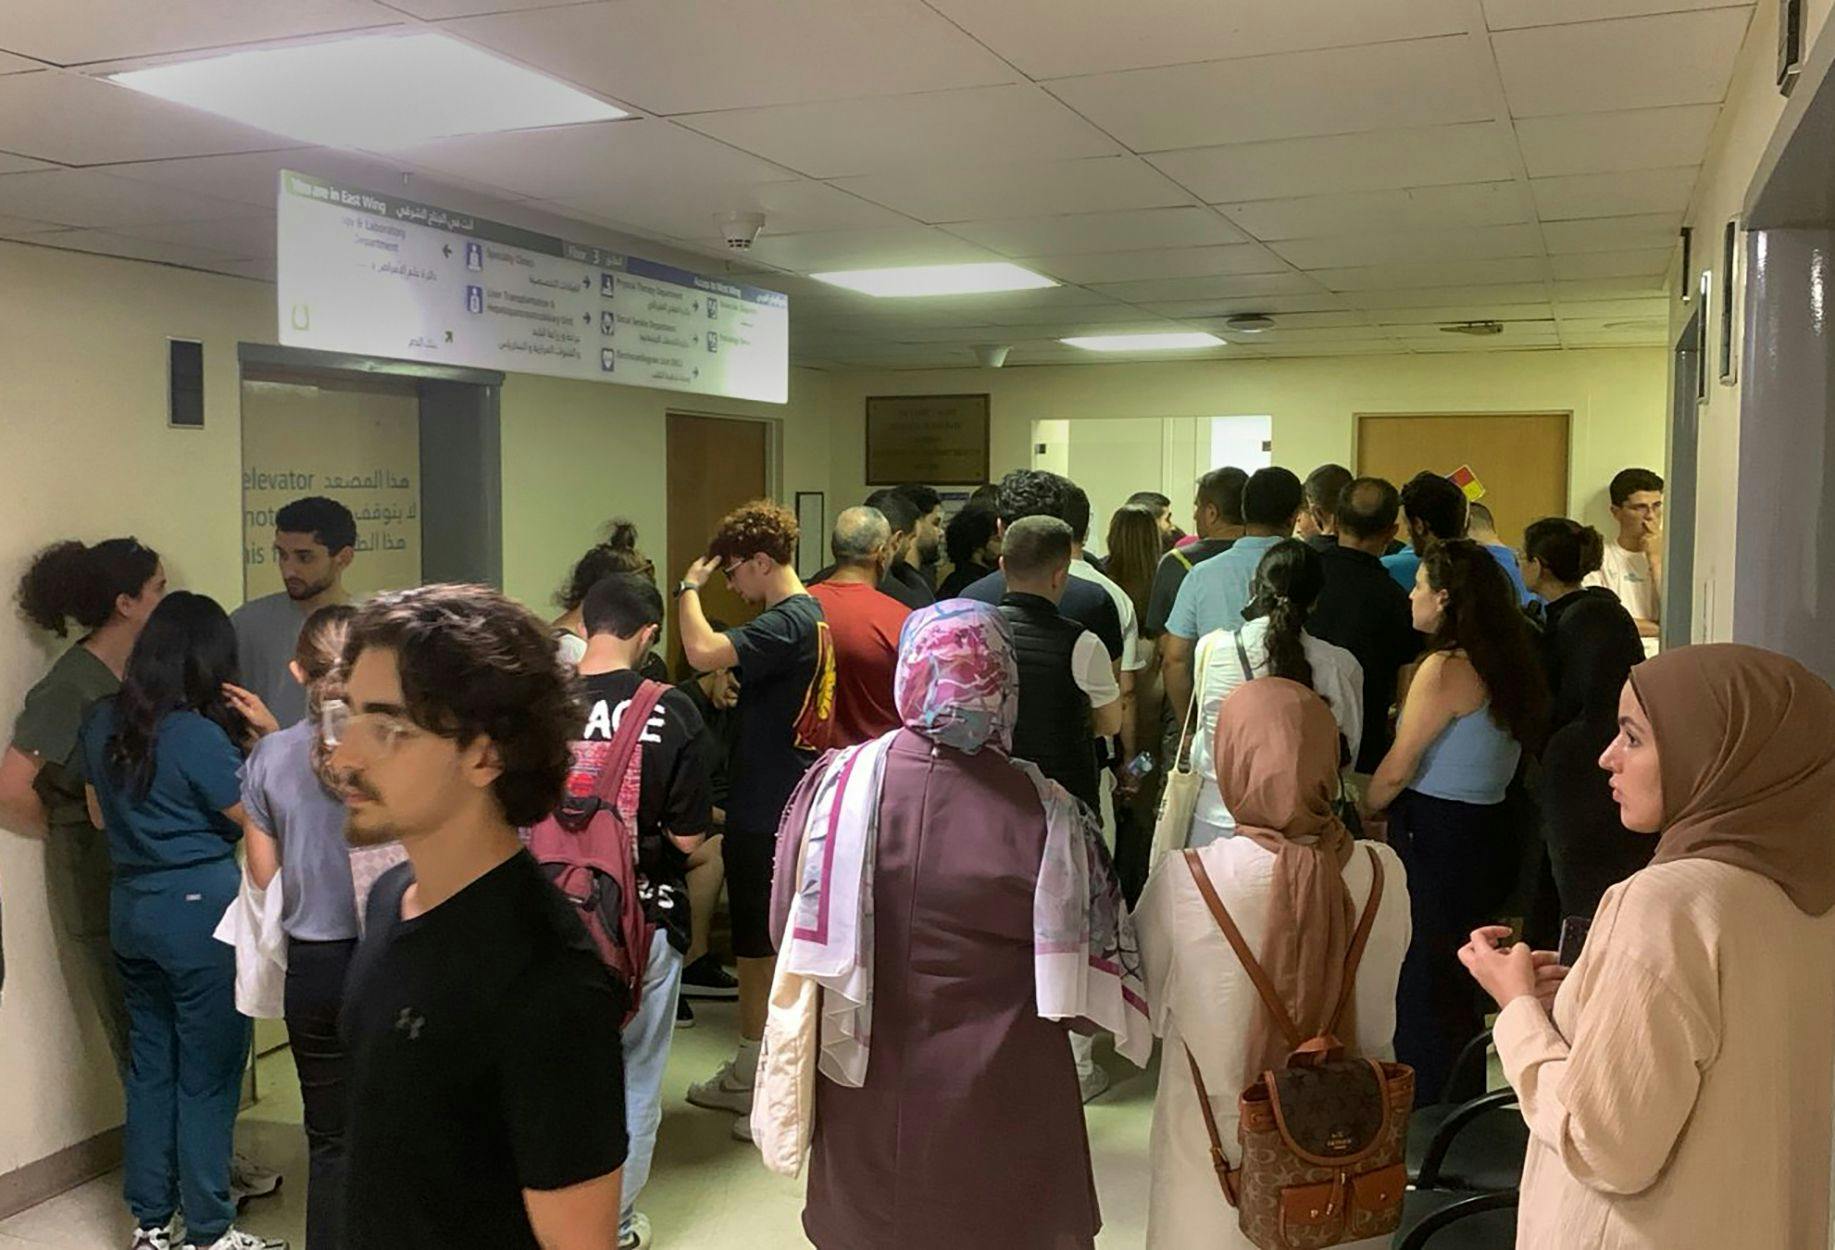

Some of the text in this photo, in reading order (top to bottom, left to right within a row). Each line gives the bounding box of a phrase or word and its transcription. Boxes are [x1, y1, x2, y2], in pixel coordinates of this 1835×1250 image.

[291, 178, 387, 215] You are in East Wing
[243, 467, 314, 490] elevator
[323, 469, 383, 489] المصعد
